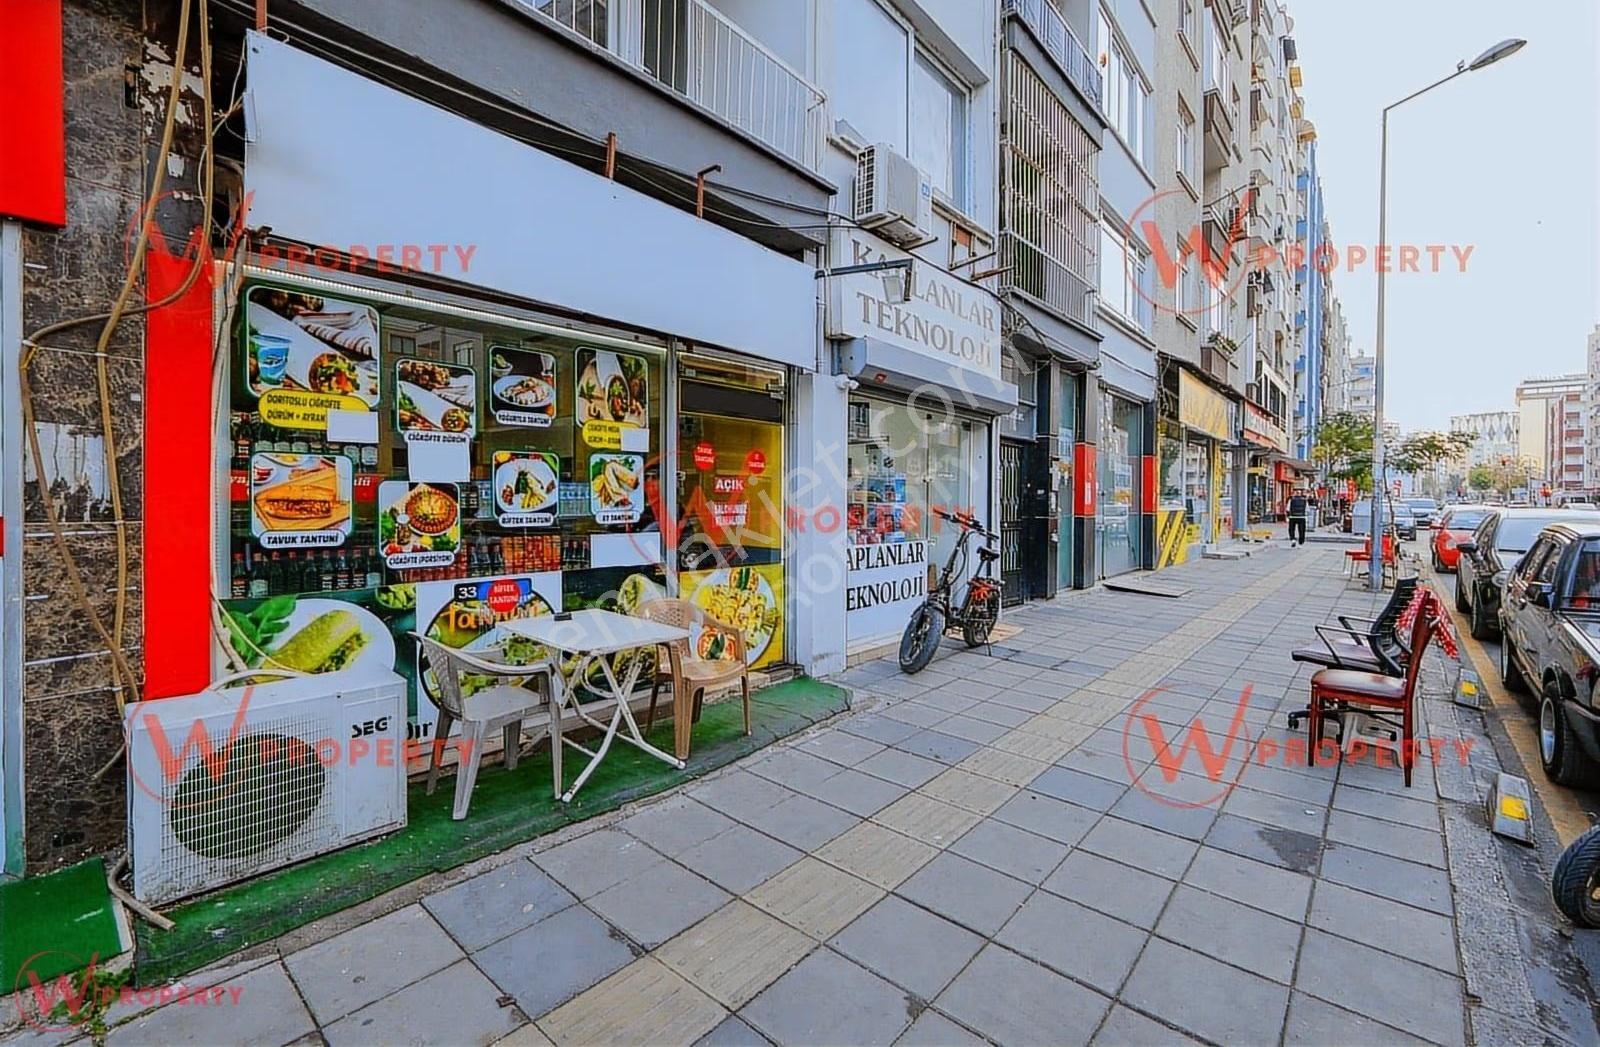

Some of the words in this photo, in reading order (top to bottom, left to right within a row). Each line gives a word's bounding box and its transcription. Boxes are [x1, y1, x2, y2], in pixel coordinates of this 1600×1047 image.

[852, 240, 995, 331] KALANLAR
[857, 291, 992, 368] TEKNOLOJİ
[715, 478, 744, 493] AÇIK
[266, 534, 298, 545] TAVUK
[458, 586, 477, 599] 33
[351, 716, 388, 739] SEG
